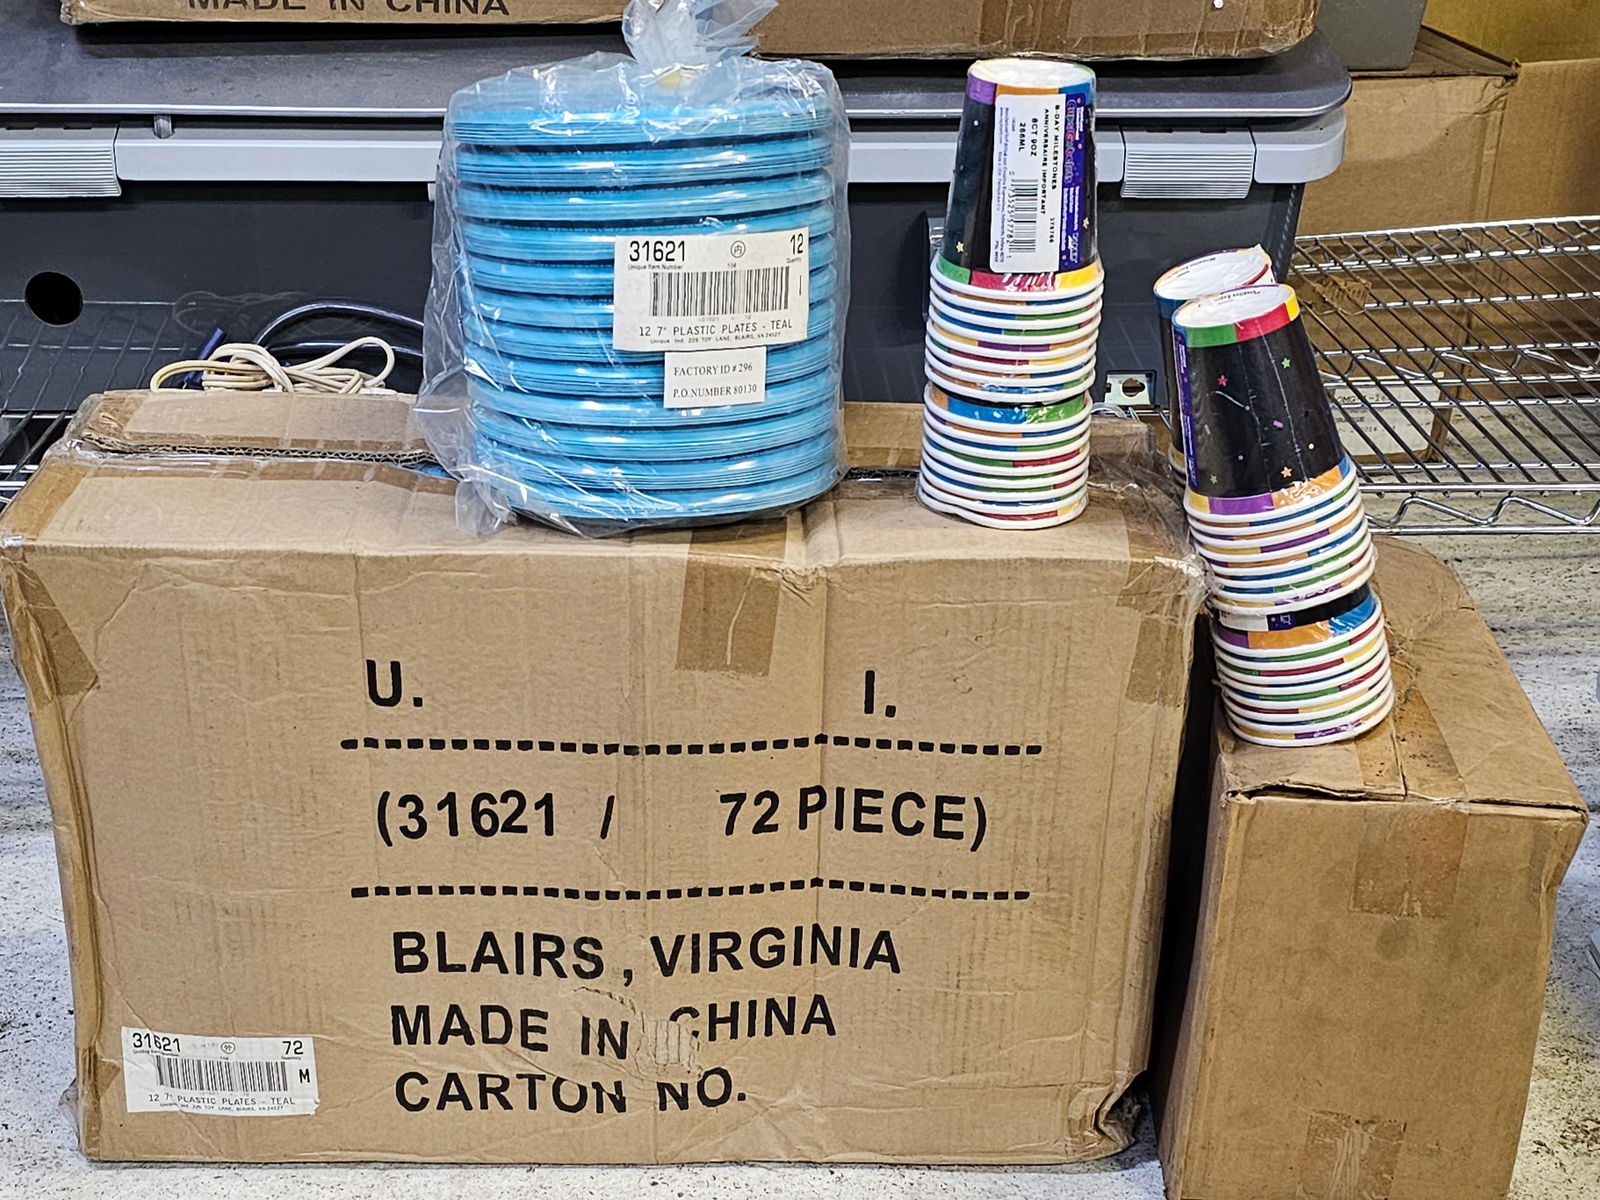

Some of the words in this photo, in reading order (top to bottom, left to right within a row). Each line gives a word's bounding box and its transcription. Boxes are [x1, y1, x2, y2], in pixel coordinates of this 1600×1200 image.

[1042, 108, 1050, 167] ANNIVERSAIRE
[1051, 135, 1059, 190] MILESTONES
[1040, 169, 1048, 215] IMPORTANT
[629, 240, 686, 262] 31621
[789, 232, 804, 256] 12
[639, 326, 651, 337] 12
[673, 325, 716, 336] PLASTIC
[721, 321, 758, 334] PLATES
[770, 319, 793, 330] TEAL
[673, 365, 719, 377] FACTORY
[720, 365, 731, 375] ID
[738, 362, 753, 373] 296
[733, 384, 758, 395] 80130
[365, 659, 423, 708] U.
[863, 669, 897, 718] I.
[377, 789, 554, 847] (31621
[599, 795, 616, 840] /
[719, 789, 780, 837] 72
[798, 784, 987, 853] PIECE)
[649, 922, 901, 978] VIRGINIA
[132, 1032, 181, 1053] 31621
[282, 1040, 304, 1055] 72
[390, 1003, 549, 1052] MADE
[580, 1015, 629, 1060] IN
[298, 1068, 311, 1084] M
[395, 1071, 627, 1114] CARTON
[656, 1066, 746, 1112] NO.
[148, 1093, 160, 1102] 12
[177, 1094, 217, 1105] PLASTIC
[222, 1097, 257, 1106] PLATES
[269, 1096, 296, 1105] TEAL
